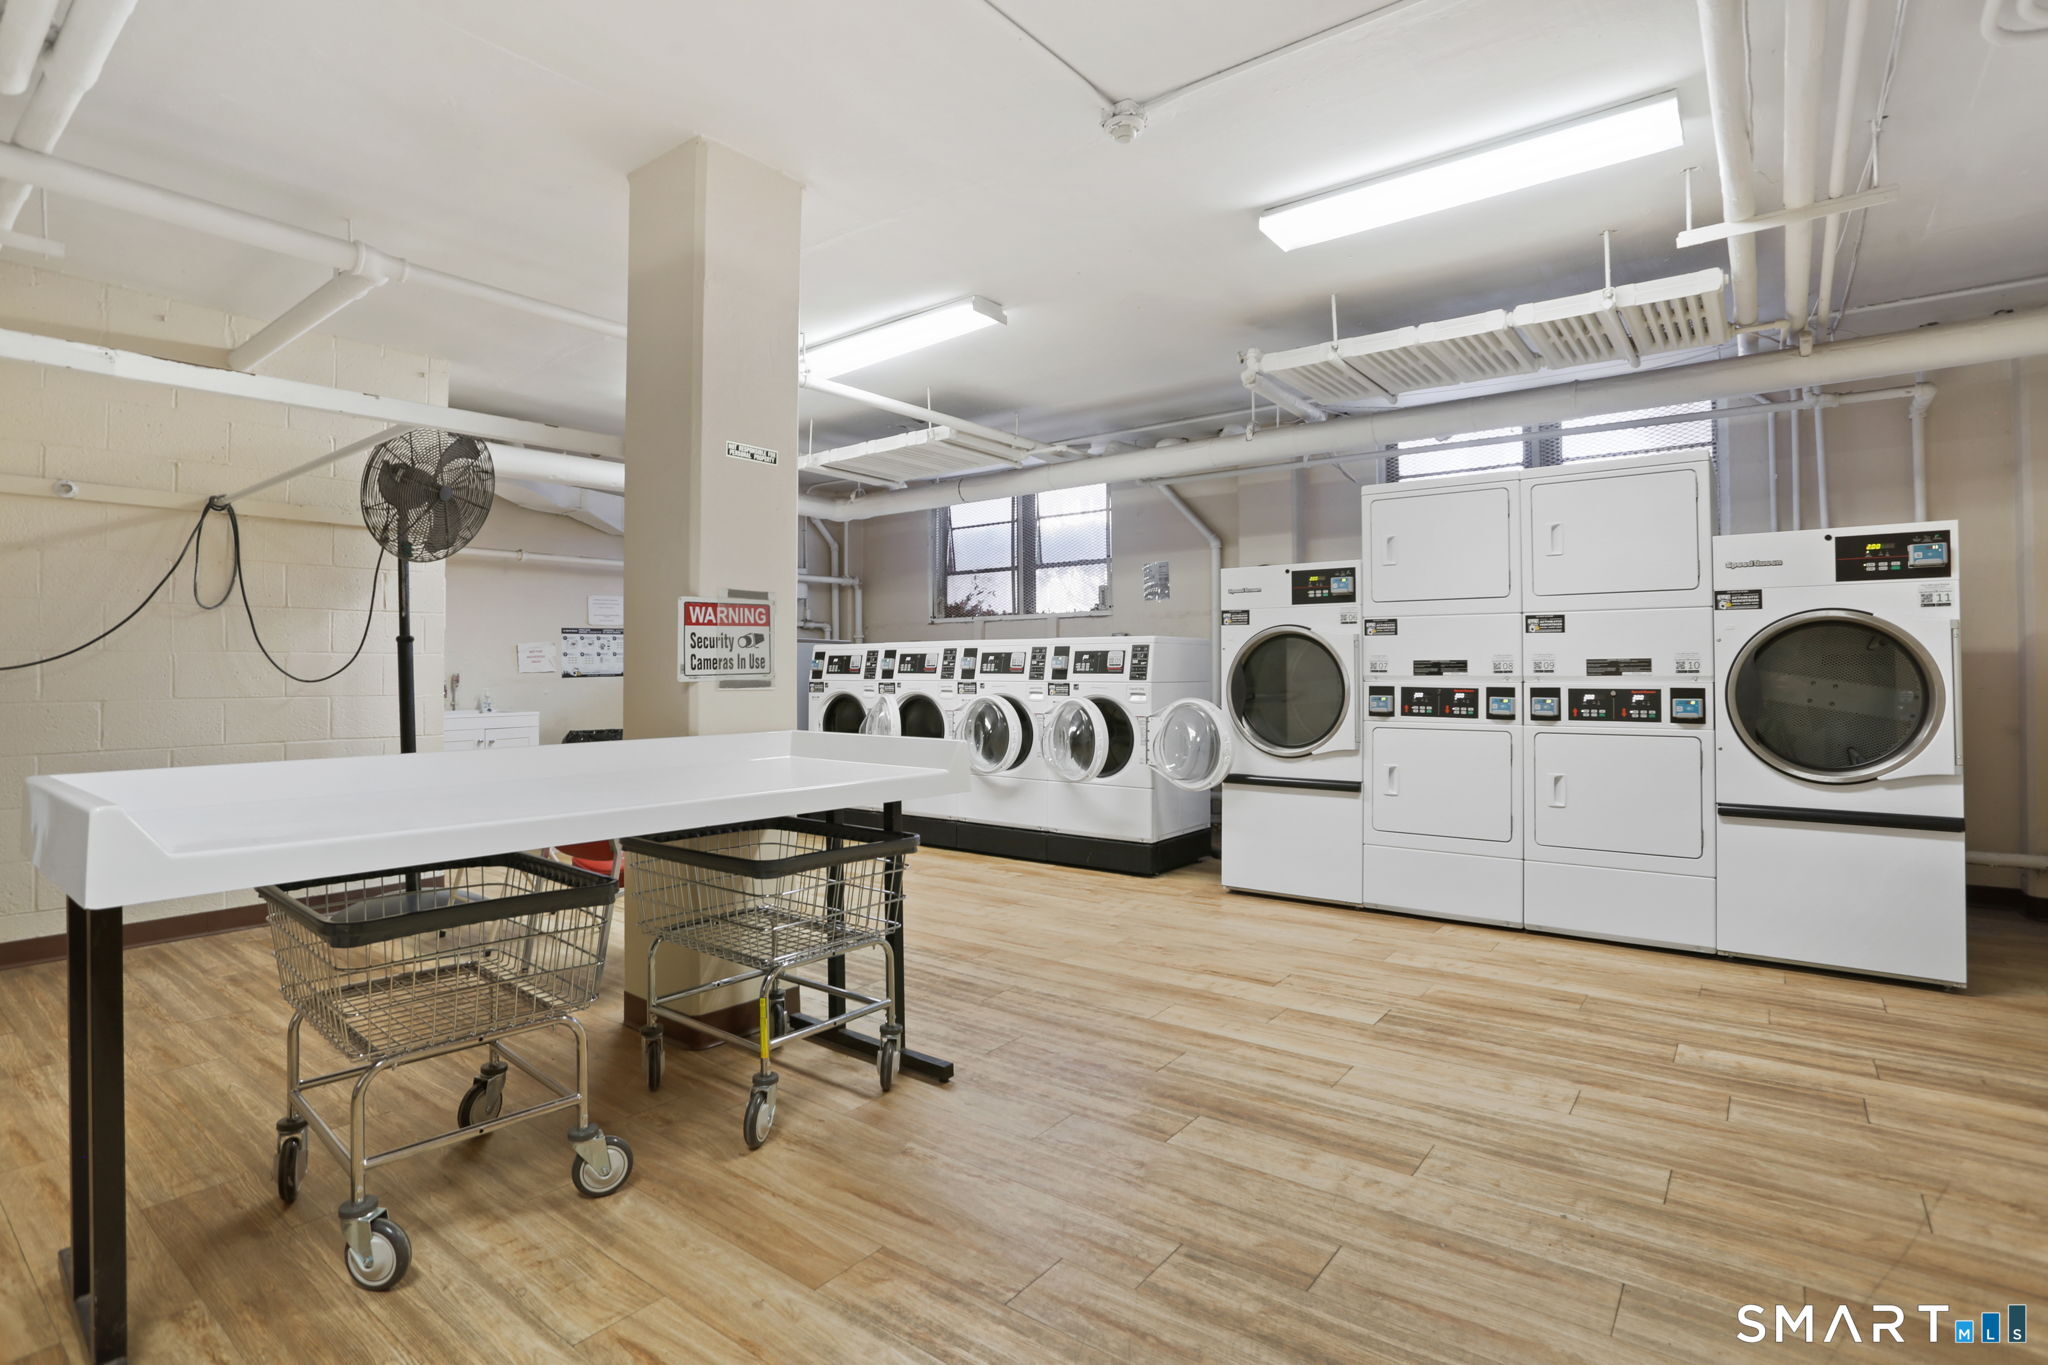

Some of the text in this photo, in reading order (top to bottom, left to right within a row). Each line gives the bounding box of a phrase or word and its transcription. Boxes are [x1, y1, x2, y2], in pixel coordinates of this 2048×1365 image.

[753, 453, 775, 463] PROPERTY
[1936, 593, 1951, 602] 11
[689, 606, 767, 624] WARNING
[690, 632, 734, 652] Security
[690, 653, 734, 671] Cameras
[737, 653, 746, 670] In
[749, 653, 766, 670] Use
[1502, 662, 1513, 670] 08
[1543, 661, 1554, 670] 09
[1688, 661, 1700, 670] 10
